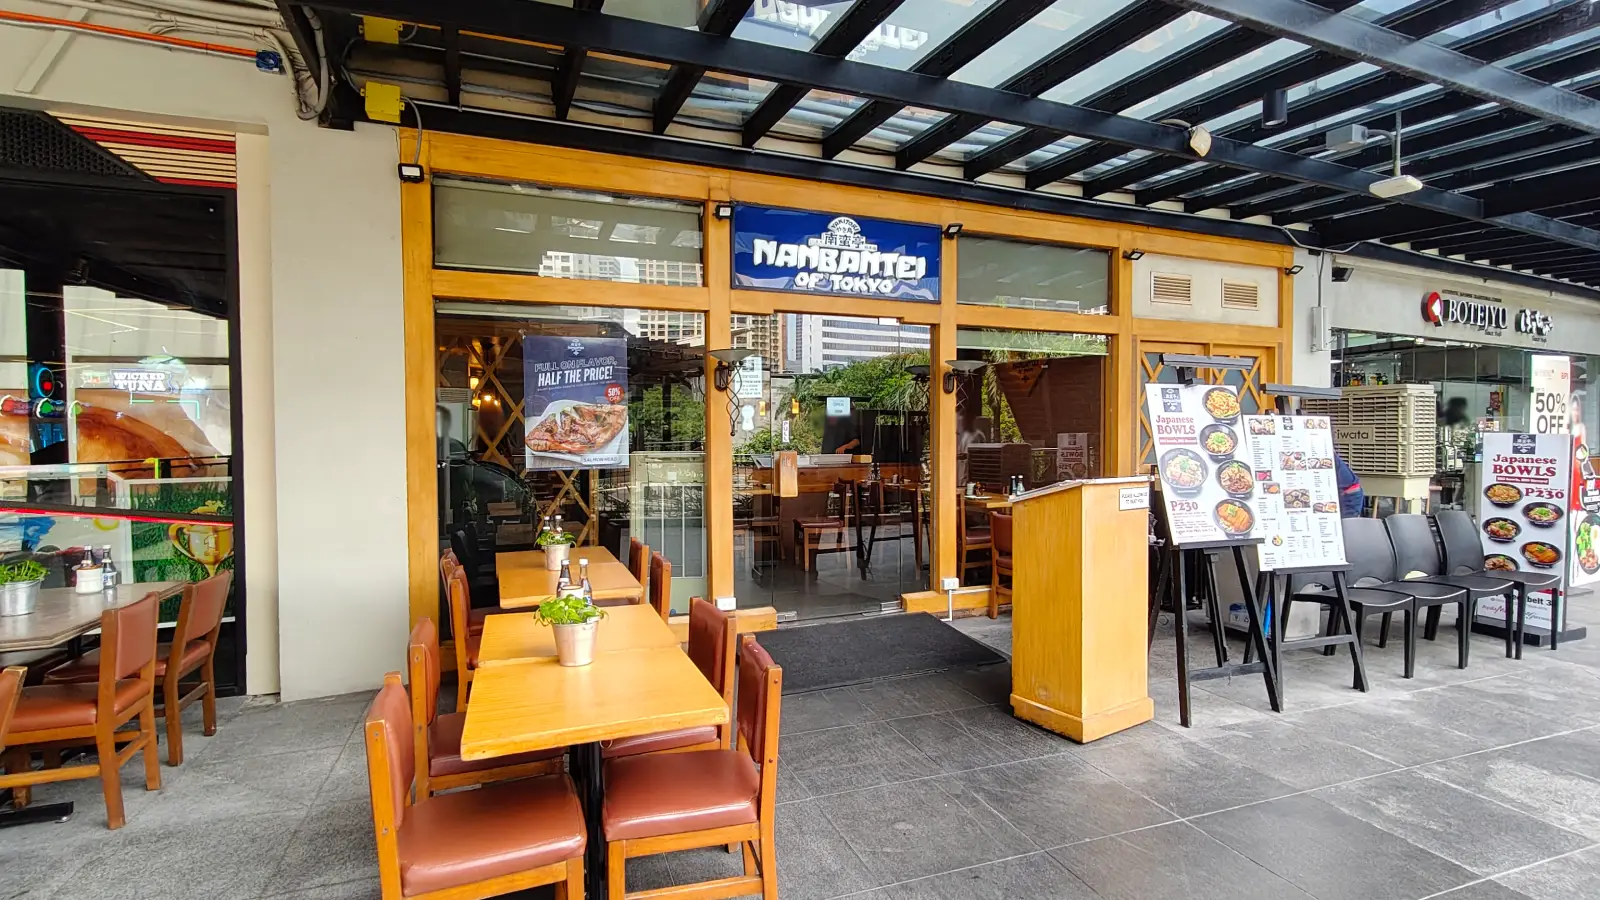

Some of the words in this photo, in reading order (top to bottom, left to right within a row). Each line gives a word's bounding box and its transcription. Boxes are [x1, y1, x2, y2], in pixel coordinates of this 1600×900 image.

[831, 218, 860, 232] YAKITORI
[795, 272, 824, 289] OF
[829, 275, 893, 293] TOKYO
[1449, 299, 1508, 329] BOTEJYU
[534, 362, 559, 373] FULL
[560, 360, 576, 370] ON
[113, 371, 165, 381] WICKED
[538, 371, 562, 387] HALF
[565, 369, 581, 384] THE
[583, 366, 613, 382] PRICE!
[114, 380, 166, 392] TUNA
[607, 387, 621, 397] 50%
[1536, 392, 1565, 414] 50%
[1156, 415, 1194, 425] Japanese
[1537, 415, 1564, 434] OFF
[1157, 425, 1196, 435] BOWLS
[1337, 429, 1369, 440] iwata
[1492, 454, 1557, 465] Japanese
[1492, 464, 1557, 477] BOWLS
[1525, 487, 1564, 500] P230
[1170, 501, 1199, 512] P230
